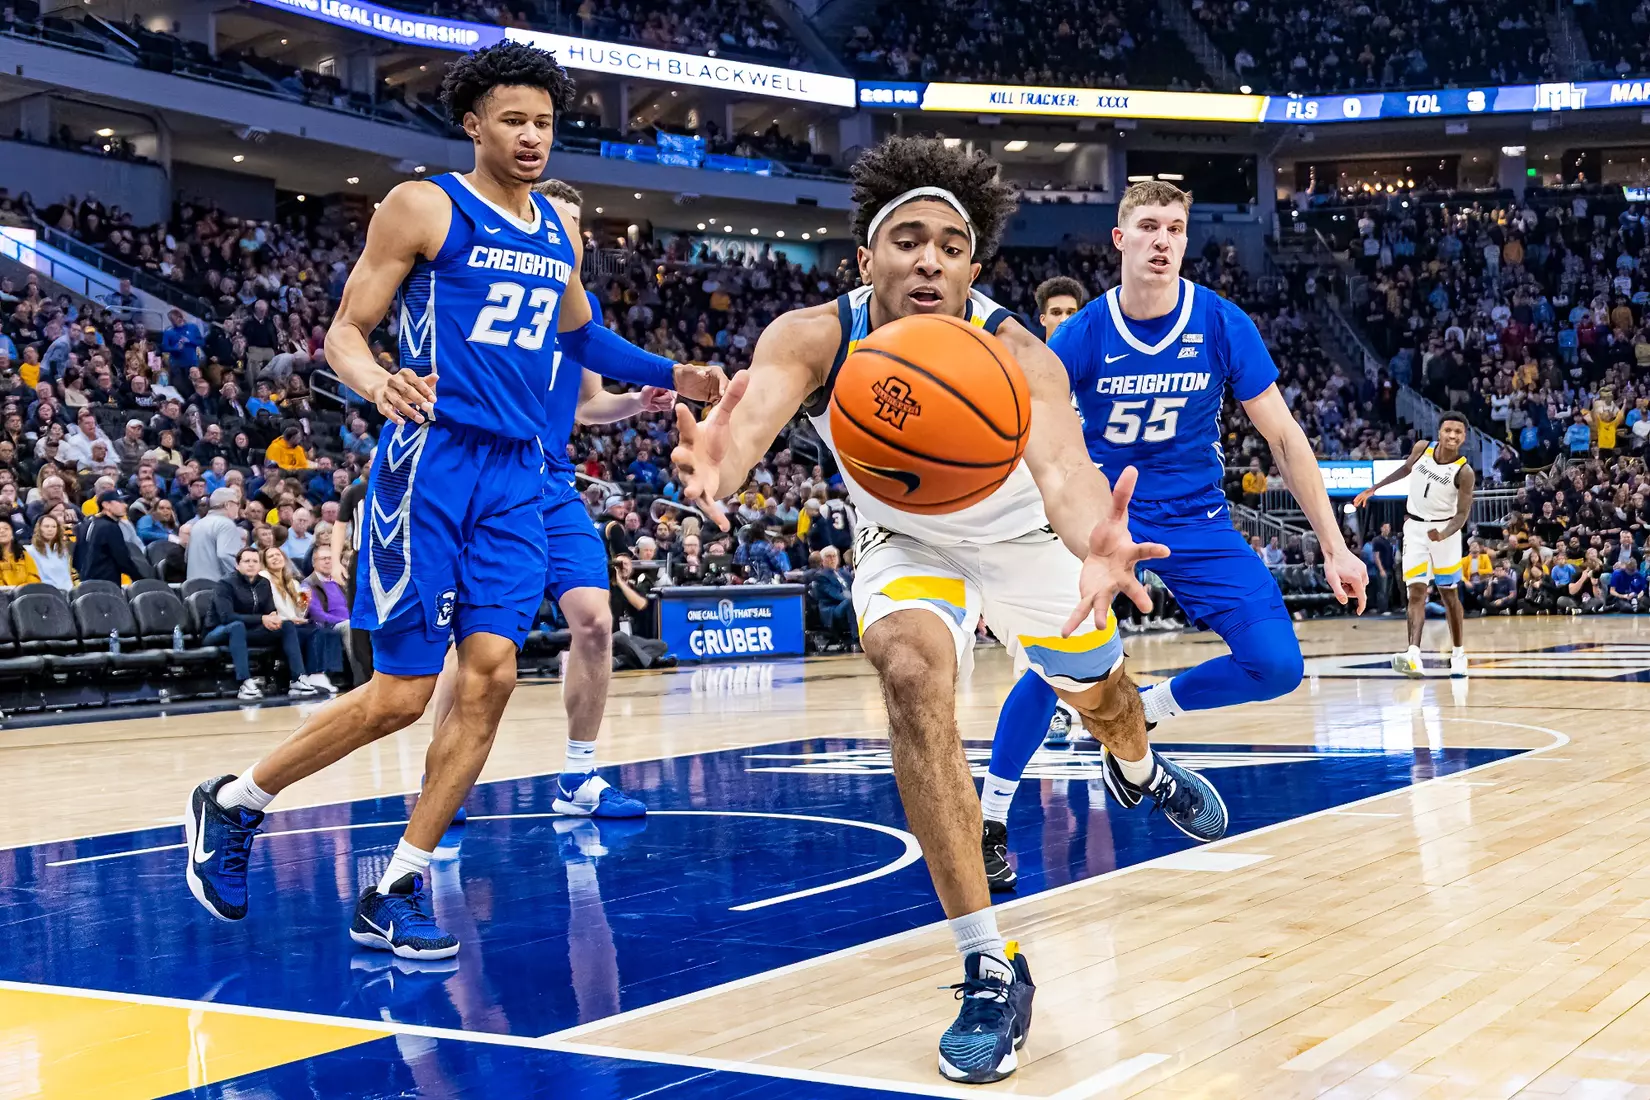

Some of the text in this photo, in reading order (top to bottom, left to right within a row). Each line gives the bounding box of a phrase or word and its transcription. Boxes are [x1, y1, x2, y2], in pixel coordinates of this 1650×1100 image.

[320, 0, 480, 46] LEGAL LEADERSHIP
[989, 91, 1129, 109] KILL TRACKER: XXXX
[1286, 101, 1318, 119] FLS
[1342, 98, 1362, 118] 0
[1406, 94, 1441, 114] TOL
[466, 245, 574, 285] CREIGHTON
[466, 281, 559, 351] 23
[1096, 372, 1211, 395] CREIGHTON
[1102, 397, 1189, 444] 55
[1423, 482, 1430, 498] 1
[831, 512, 845, 530] 3
[687, 610, 702, 621] ONE
[702, 610, 719, 620] CALL
[758, 607, 772, 618] ALL
[689, 626, 774, 656] GRUBER
